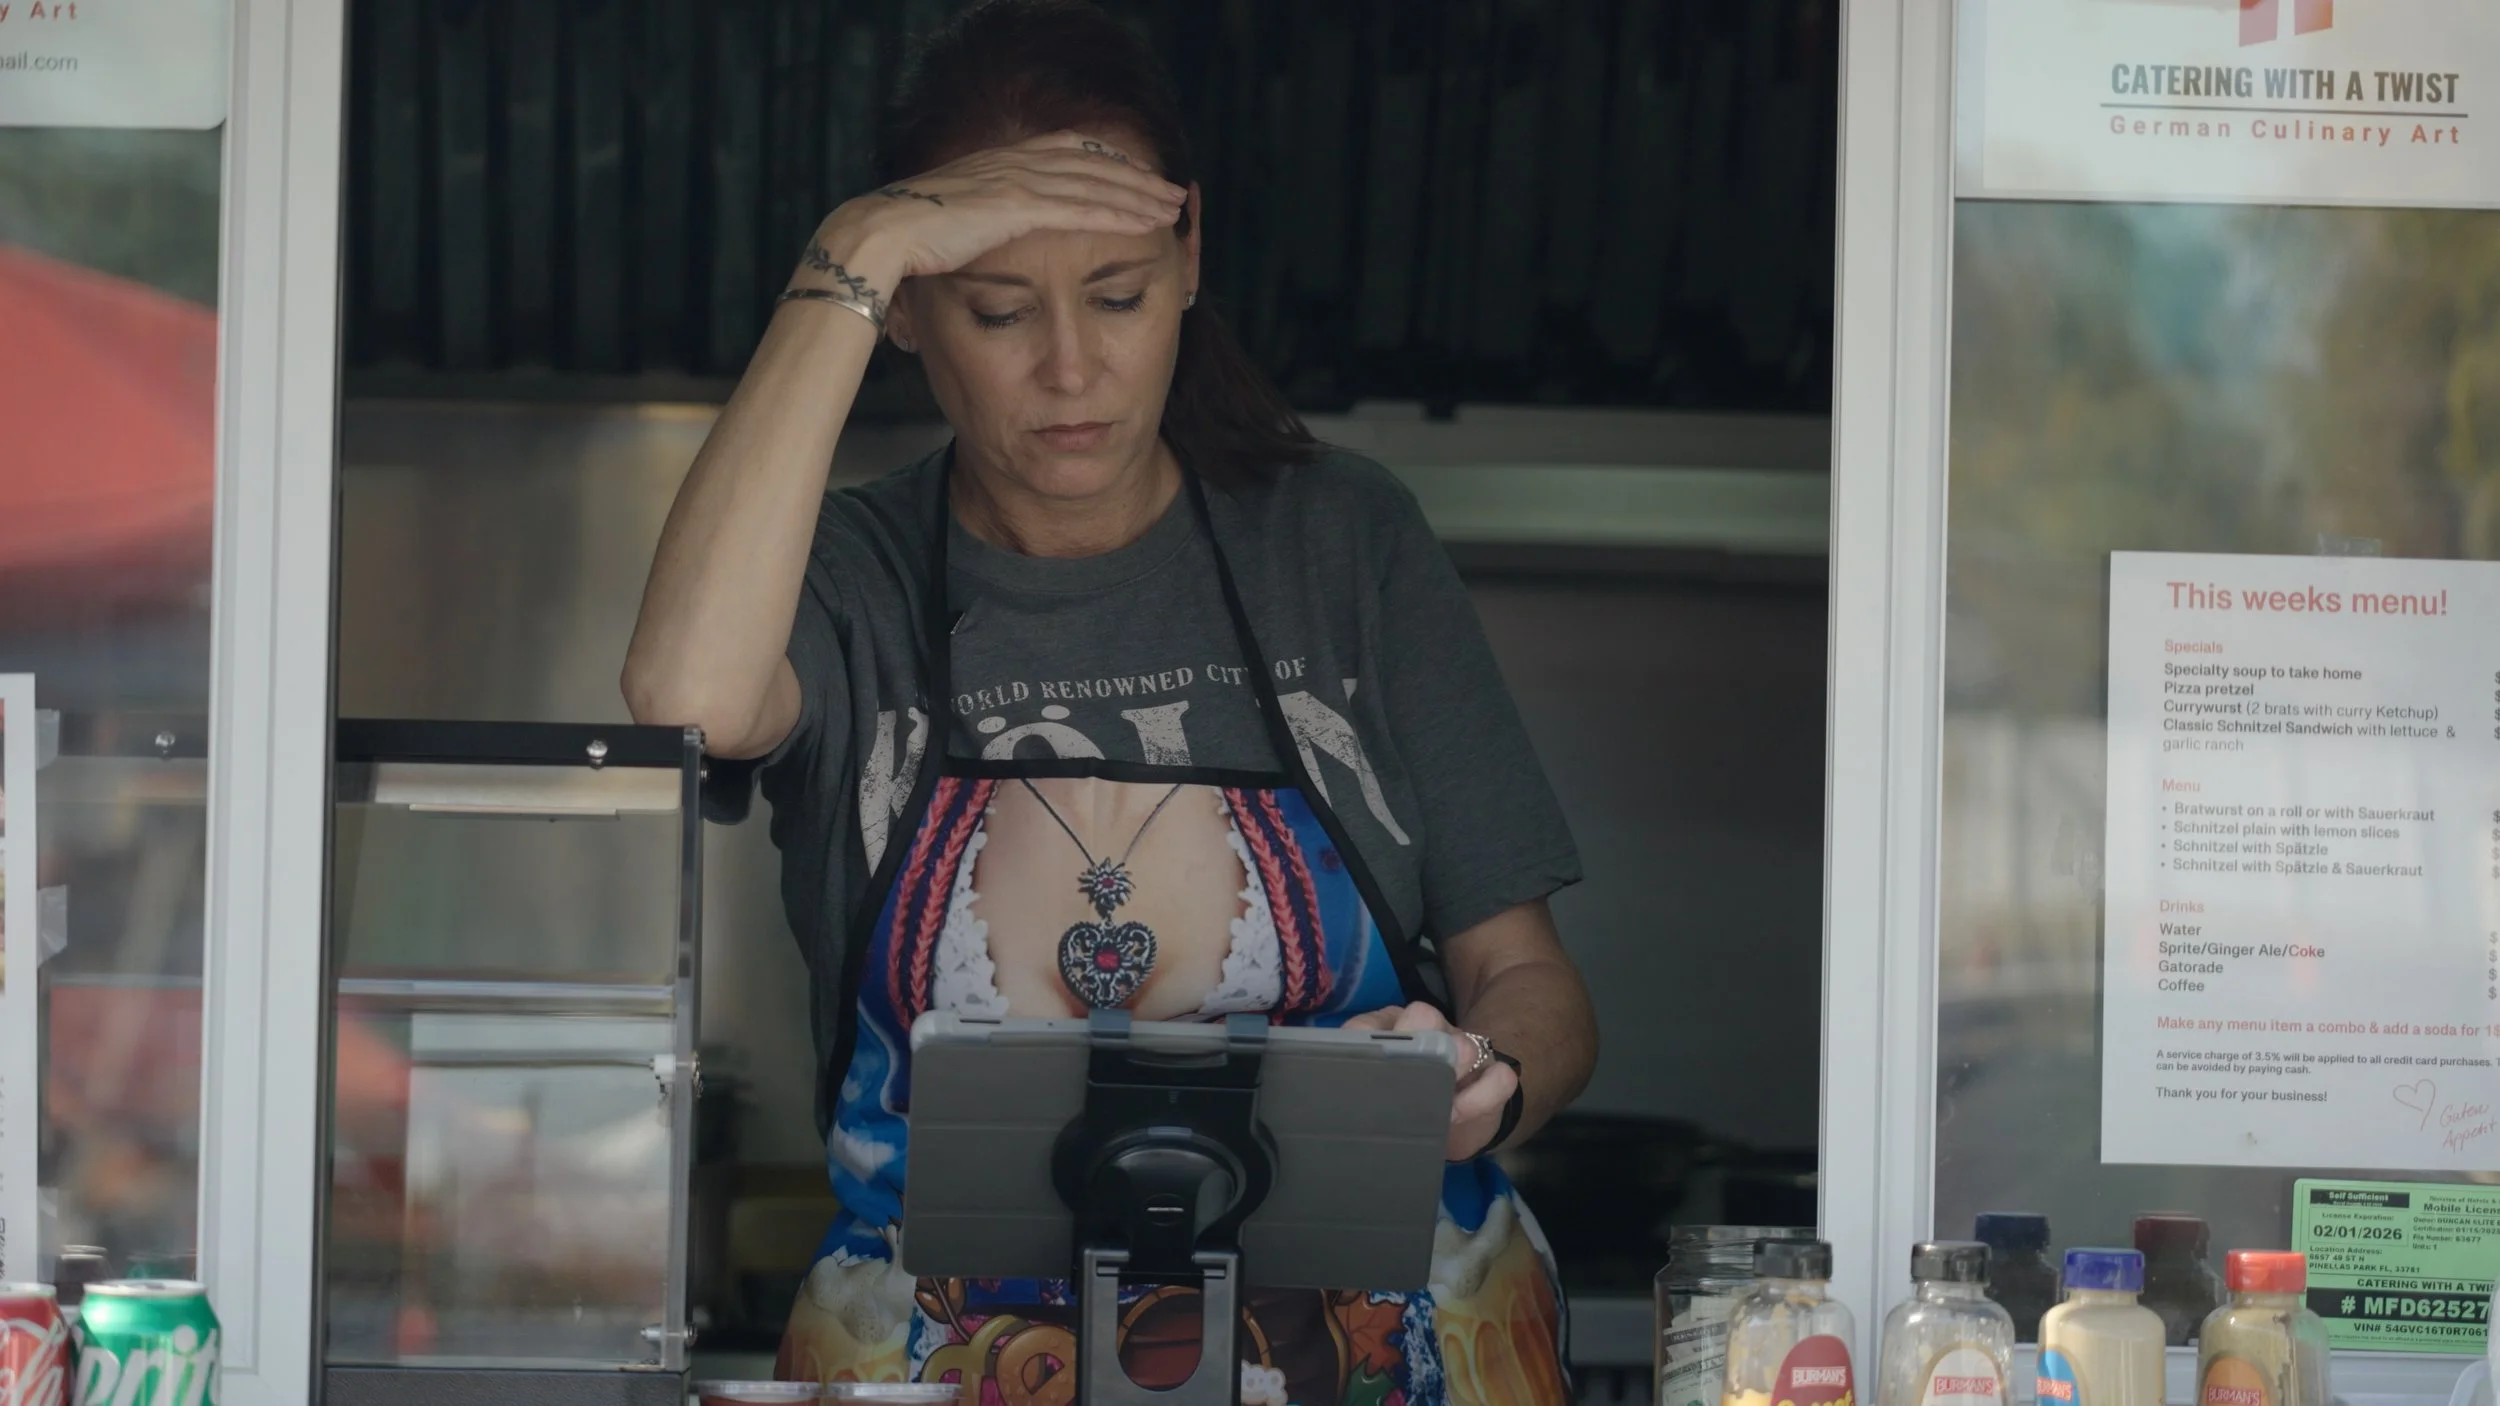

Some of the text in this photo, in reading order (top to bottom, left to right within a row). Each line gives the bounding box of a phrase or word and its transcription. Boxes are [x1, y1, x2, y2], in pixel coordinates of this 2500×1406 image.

[30, 1, 77, 20] Art
[0, 52, 77, 71] ail.com
[2112, 64, 2459, 103] CATERING WITH A TWIST
[2110, 115, 2460, 146] German Culinary Art
[2167, 582, 2448, 616] This weeks menu!
[2165, 639, 2223, 654] Specials
[2164, 663, 2362, 680] Specialty soup to take home
[951, 657, 1306, 716] ORLD RENOWNED CIT OF
[2164, 682, 2254, 697] Pizza pretzel
[2164, 700, 2438, 721] Currywurst (2 brats with curry Ketchup)
[2163, 719, 2455, 738] Classic Schnitzel Sandwich with lettuce &
[2163, 738, 2243, 753] garlic ranch
[2162, 779, 2200, 792] Menu
[2174, 803, 2434, 821] Bratwurst on a roll or with Sauerkraut
[2174, 822, 2399, 839] Schnitzel plain with lemon slices
[2174, 840, 2327, 858] Schnitzel with Spätzle
[2173, 859, 2423, 877] Schnitzel with Spätzle & Sauerkraut
[2160, 900, 2204, 913] Drinks
[2160, 923, 2201, 936] Water
[2159, 942, 2325, 958] Sprite/Ginger Ale/Coke
[2159, 961, 2223, 973] Gatorade
[2158, 979, 2204, 991] Coffee
[2157, 1017, 2194, 1030] Make
[2198, 1019, 2222, 1032] any
[2227, 1020, 2266, 1032] menu
[2271, 1019, 2302, 1032] item
[2307, 1023, 2314, 1033] a
[2318, 1021, 2365, 1034] combo
[2370, 1022, 2379, 1034] &
[2383, 1023, 2408, 1035] add
[2413, 1025, 2421, 1036] a
[2425, 1024, 2456, 1036] soda
[2461, 1024, 2479, 1037] for
[2157, 1050, 2164, 1059] A
[2167, 1051, 2201, 1061] service
[2205, 1052, 2239, 1062] charge
[2242, 1052, 2252, 1061] of
[2255, 1052, 2280, 1062] 3.5%
[2283, 1053, 2300, 1063] will
[2303, 1053, 2314, 1063] be
[2318, 1054, 2354, 1065] applied
[2357, 1055, 2367, 1064] to
[2370, 1054, 2380, 1064] all
[2384, 1055, 2412, 1065] credit
[2415, 1056, 2436, 1066] card
[2440, 1058, 2491, 1068] purchases.
[2156, 1062, 2311, 1075] can be avoided by paying cash.
[2156, 1087, 2327, 1103] Thank you for your business!
[2348, 1193, 2388, 1201] Sufficient
[2424, 1204, 2460, 1212] Mobile
[2314, 1225, 2402, 1240] 02/01/2026
[2358, 1279, 2418, 1289] CATERING
[2422, 1281, 2452, 1290] WITH
[2457, 1282, 2464, 1291] A
[2342, 1296, 2489, 1319] # MFD62527
[2354, 1323, 2380, 1332] VIN#
